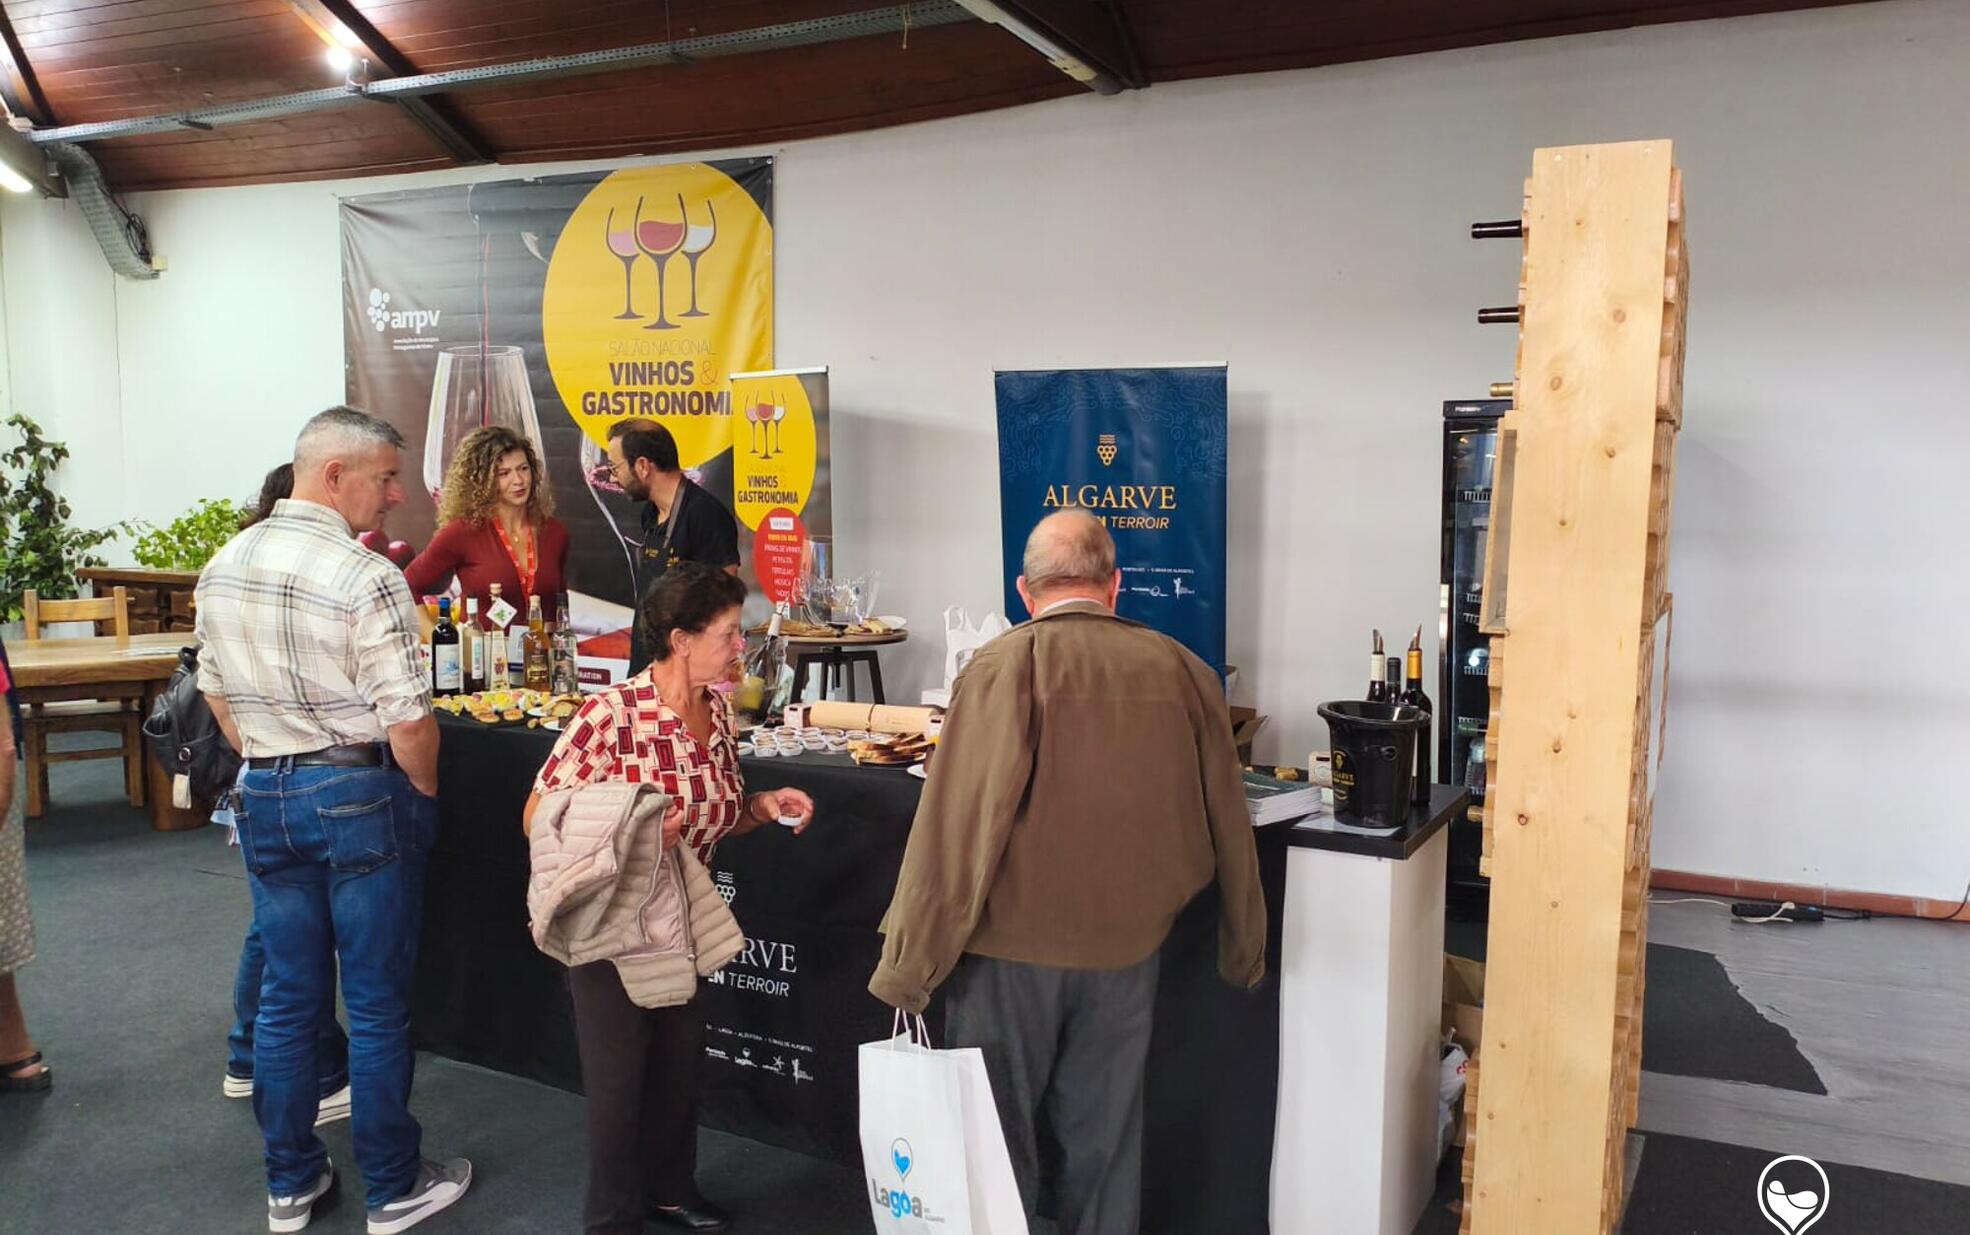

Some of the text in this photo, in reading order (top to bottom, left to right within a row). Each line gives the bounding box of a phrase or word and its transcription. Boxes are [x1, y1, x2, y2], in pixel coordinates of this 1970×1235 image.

[391, 310, 440, 334] ampv
[609, 338, 718, 357] SALÃO NACIONAL
[609, 360, 719, 386] VINHOS &
[582, 390, 733, 416] GASTRONOMI
[747, 475, 779, 488] VINHOS
[738, 490, 798, 504] GASTRONOMIA
[1043, 484, 1177, 509] ALGARVE
[1111, 516, 1169, 529] TERROIR
[729, 972, 790, 997] TERROIR
[872, 1178, 922, 1218] Lagoa
